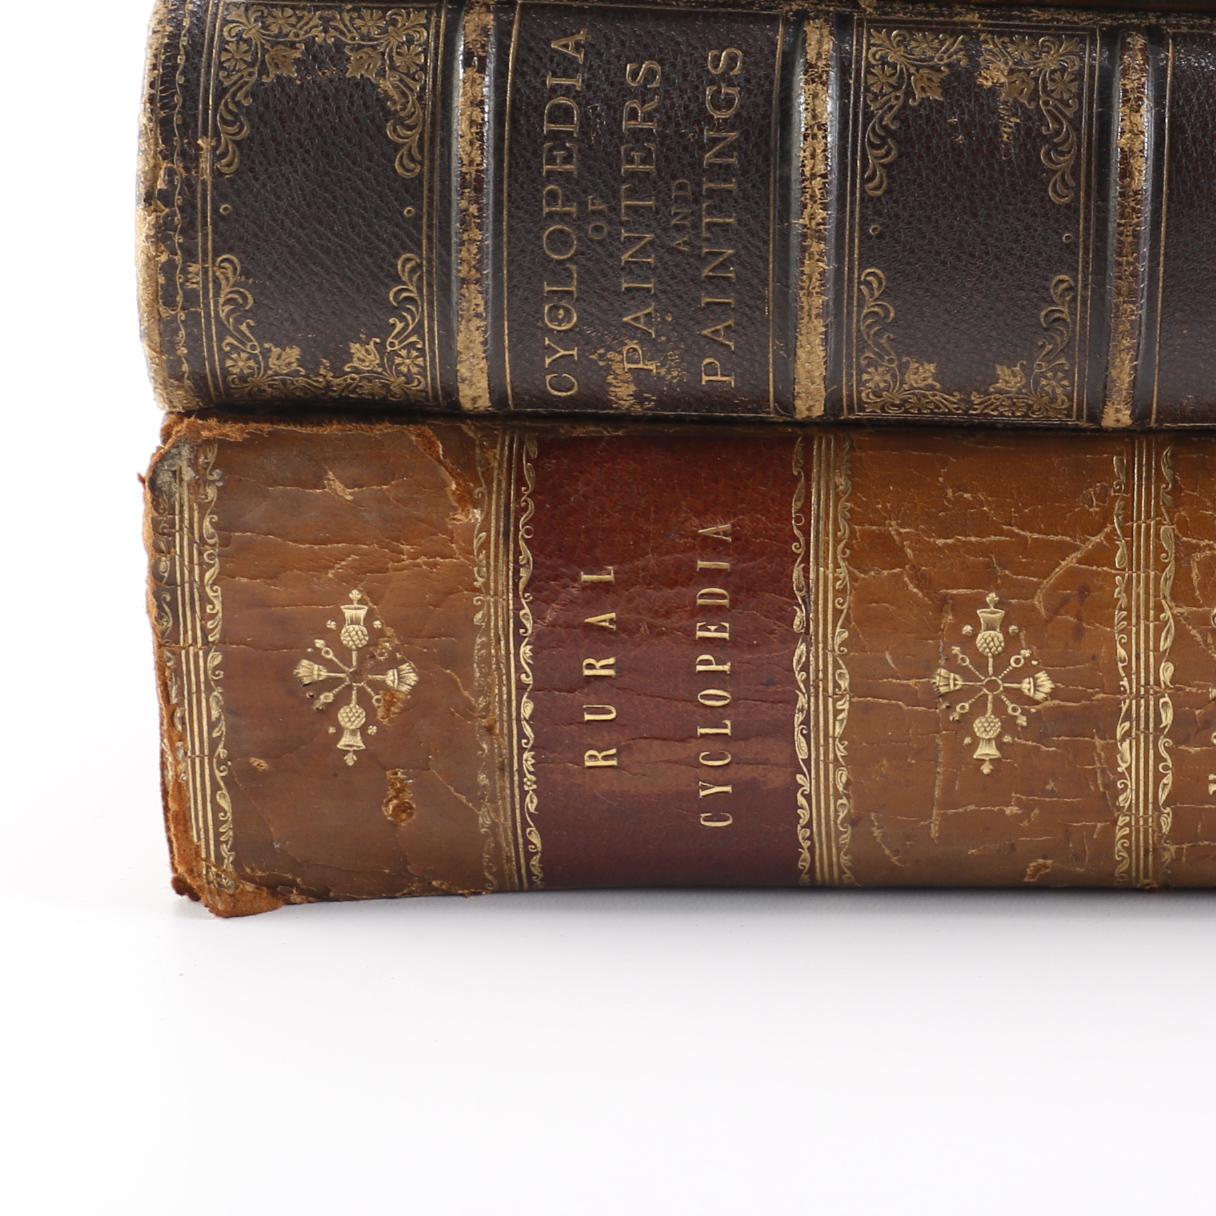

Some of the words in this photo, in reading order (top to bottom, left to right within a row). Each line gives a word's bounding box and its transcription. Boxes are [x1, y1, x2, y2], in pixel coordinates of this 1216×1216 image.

[541, 27, 590, 399] CYCLOPEDIA
[586, 193, 610, 242] OF
[619, 57, 663, 376] PAINTERS
[670, 176, 694, 253] AND
[699, 45, 745, 389] PAINTINGS
[579, 563, 620, 769] RURAL
[694, 520, 735, 829] CYCLOPEDIA
